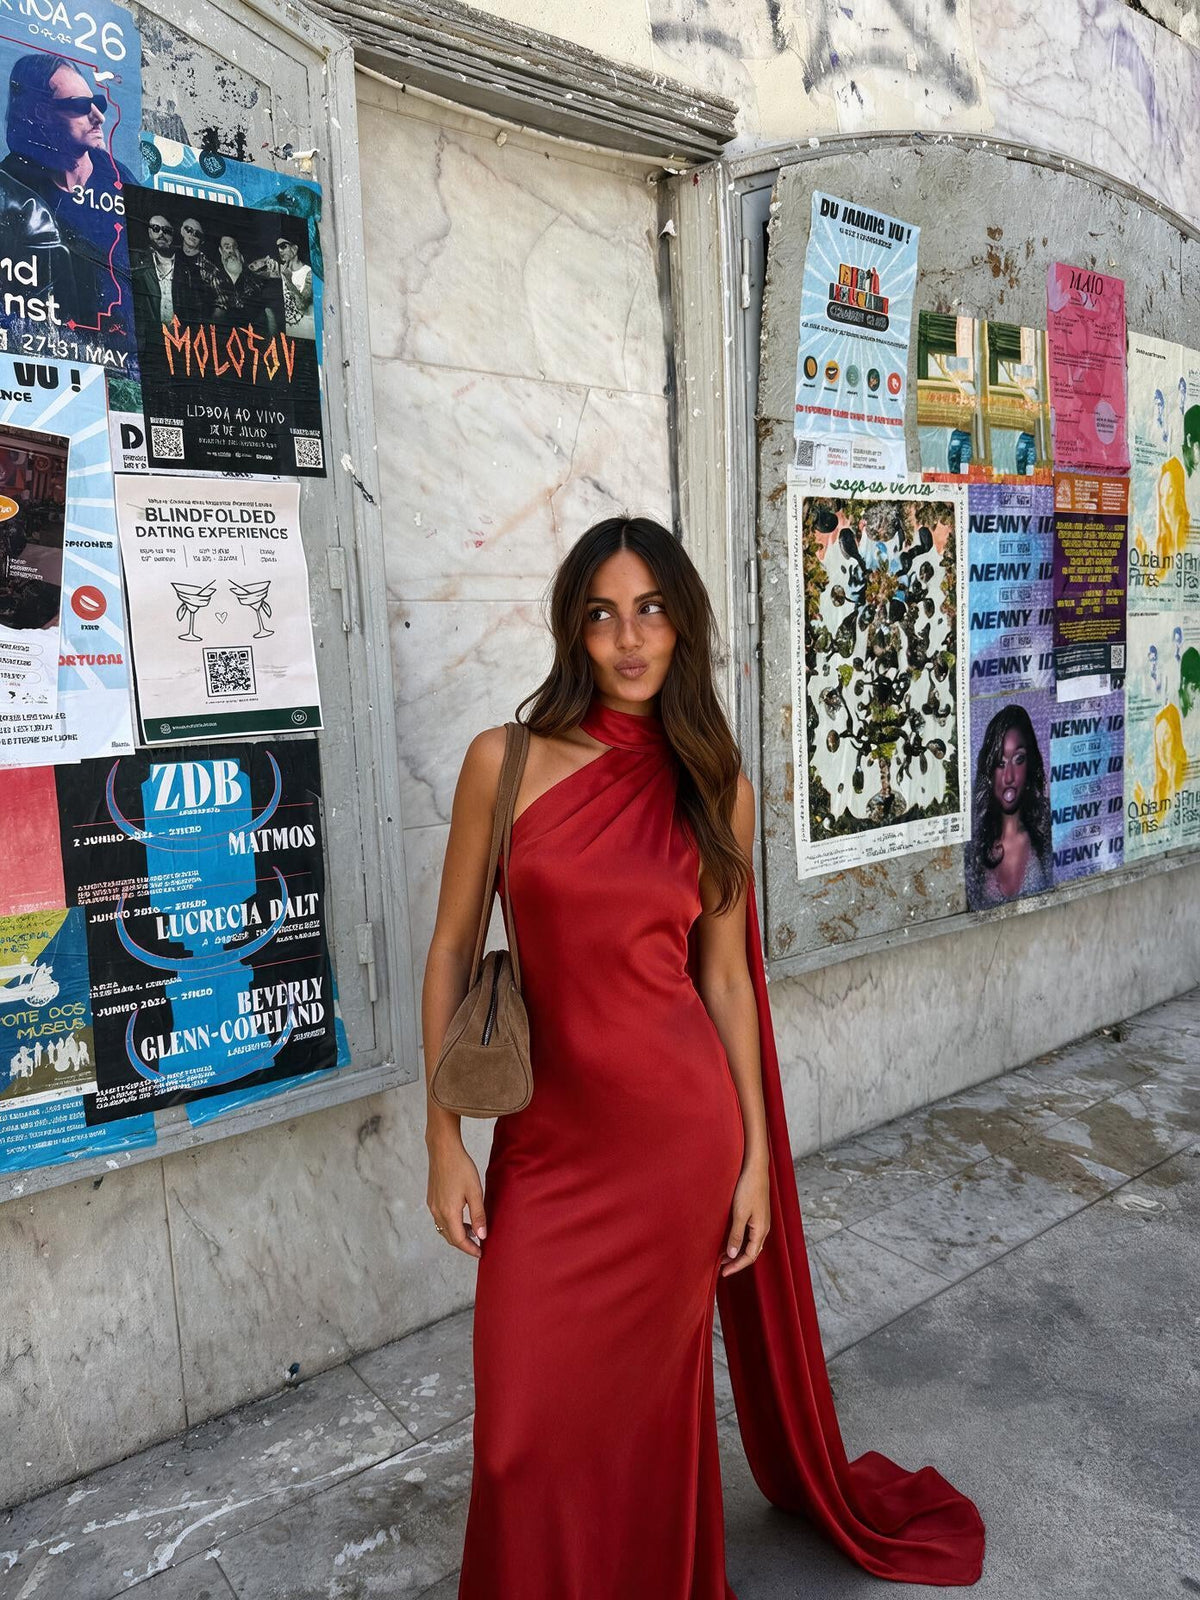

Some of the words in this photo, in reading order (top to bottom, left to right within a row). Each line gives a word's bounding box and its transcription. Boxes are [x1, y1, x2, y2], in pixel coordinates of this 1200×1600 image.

[72, 184, 125, 215] 31.05
[820, 198, 839, 220] DU
[86, 345, 128, 367] MAY
[13, 362, 59, 390] VU
[145, 507, 276, 523] BLINDFOLDED
[969, 515, 1032, 533] NENNY
[135, 526, 195, 538] DATING
[970, 563, 1031, 582] NENNY
[971, 610, 1031, 630] NENNY
[971, 655, 1032, 678] NENNY
[1050, 717, 1101, 739] NENNY
[1107, 715, 1123, 732] ID
[1050, 758, 1101, 782] NENNY
[1107, 756, 1123, 773] ID
[152, 760, 243, 811] ZDB
[1051, 800, 1101, 825] NENNY
[1107, 796, 1123, 813] ID
[228, 824, 316, 855] MATMOS
[1052, 840, 1103, 868] NENNY
[1108, 836, 1123, 853] ID
[156, 901, 263, 940] LUCRECIA
[269, 893, 319, 922] DALT
[237, 977, 324, 1015] BEVERLY
[0, 1010, 39, 1027] OITE
